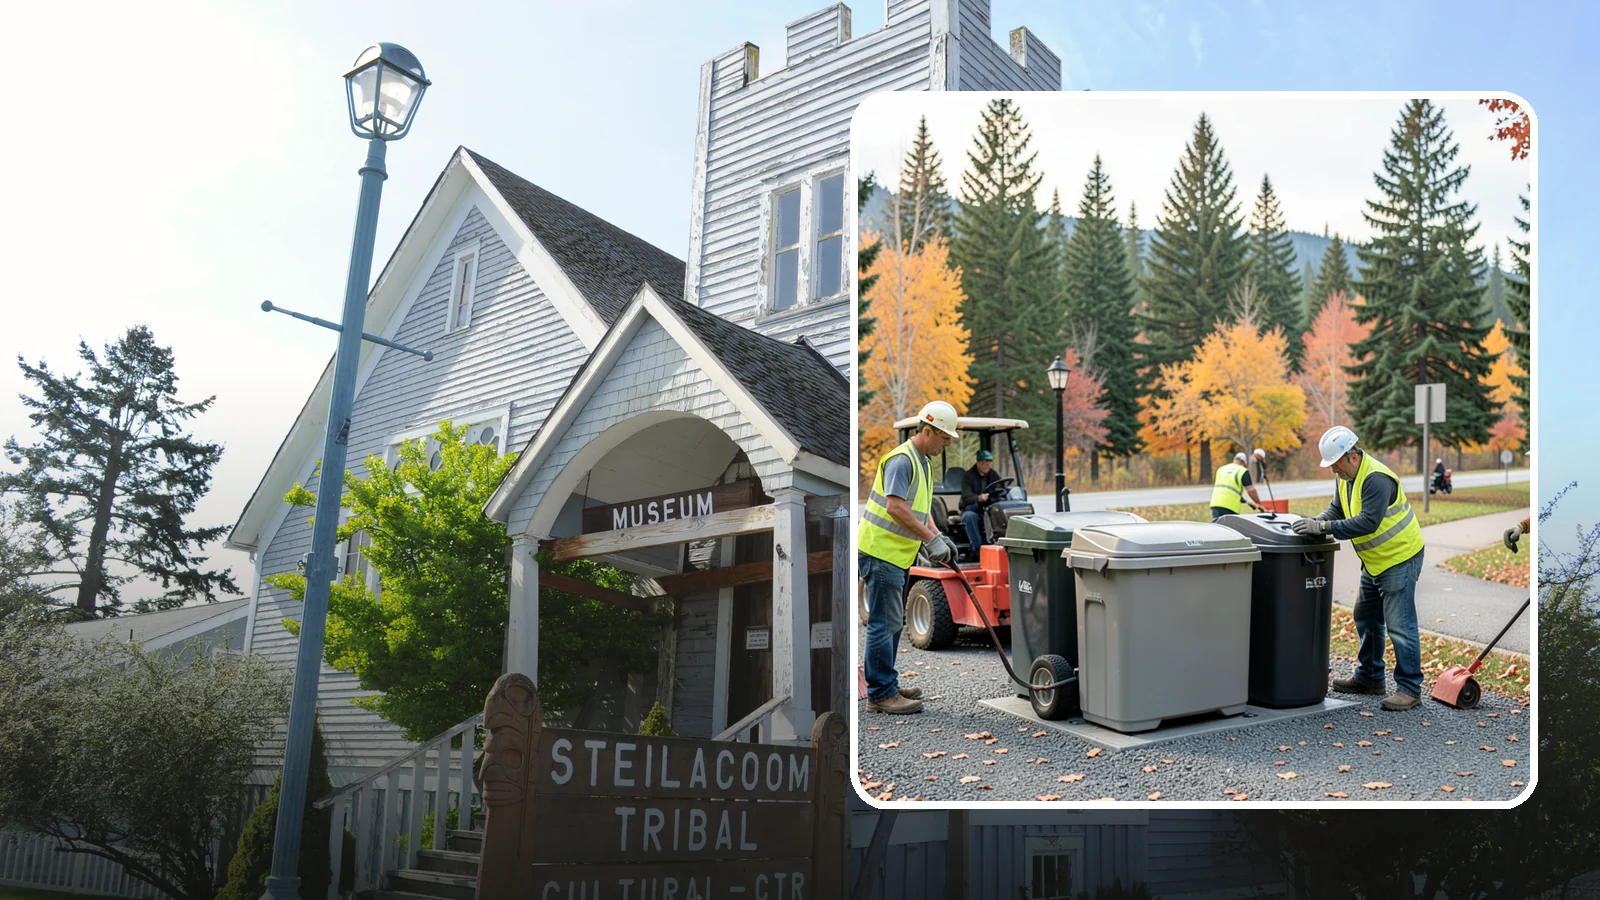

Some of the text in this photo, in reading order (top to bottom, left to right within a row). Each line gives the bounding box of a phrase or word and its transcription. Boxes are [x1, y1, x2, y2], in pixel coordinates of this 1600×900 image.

[613, 491, 714, 531] MUSEUM
[550, 738, 810, 793] STEILACOOM
[614, 806, 758, 853] TRIBAL
